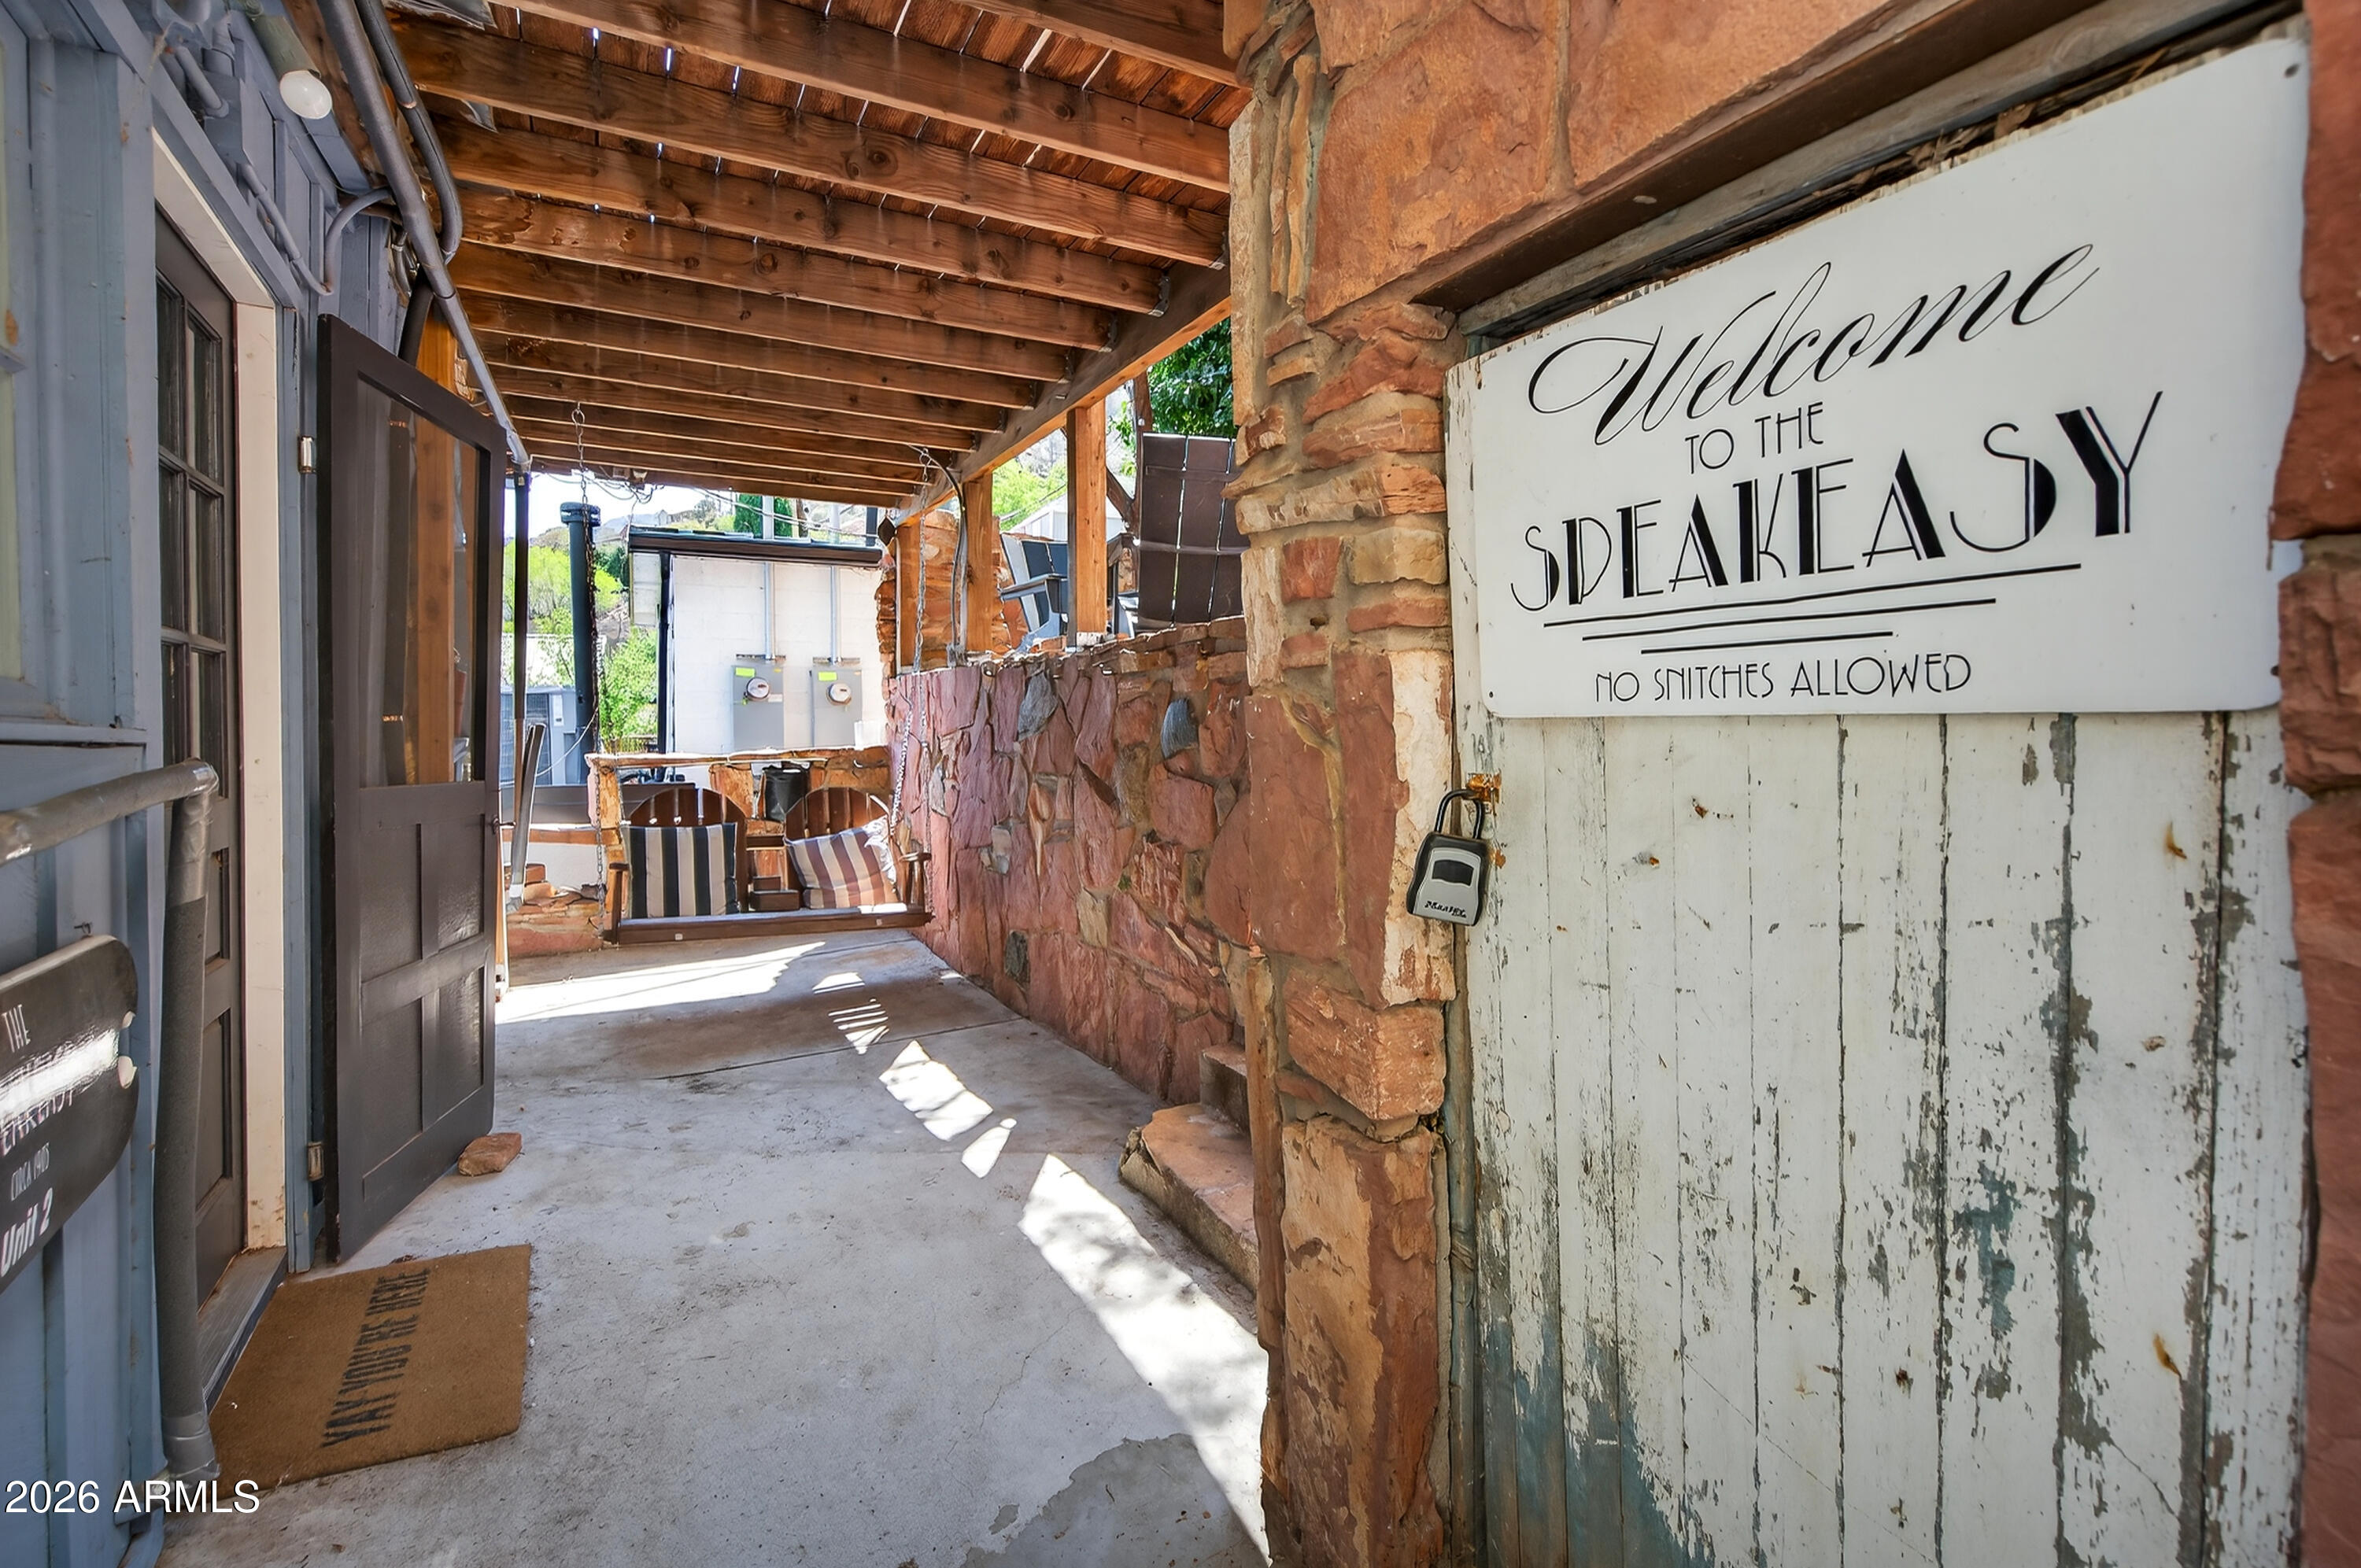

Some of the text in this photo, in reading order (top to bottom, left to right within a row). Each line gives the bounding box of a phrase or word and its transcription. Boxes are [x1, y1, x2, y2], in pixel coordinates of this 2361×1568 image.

[1528, 245, 2100, 446] Welcome
[1684, 402, 1824, 474] TO THE
[1510, 391, 2163, 611] SPEAKEASY
[1595, 653, 1971, 703] NO SNITCHES ALLOWED
[2, 1004, 31, 1053] THE
[1, 1187, 54, 1278] Unit 2
[321, 1393, 400, 1448] YAY
[365, 1267, 430, 1317] HERE
